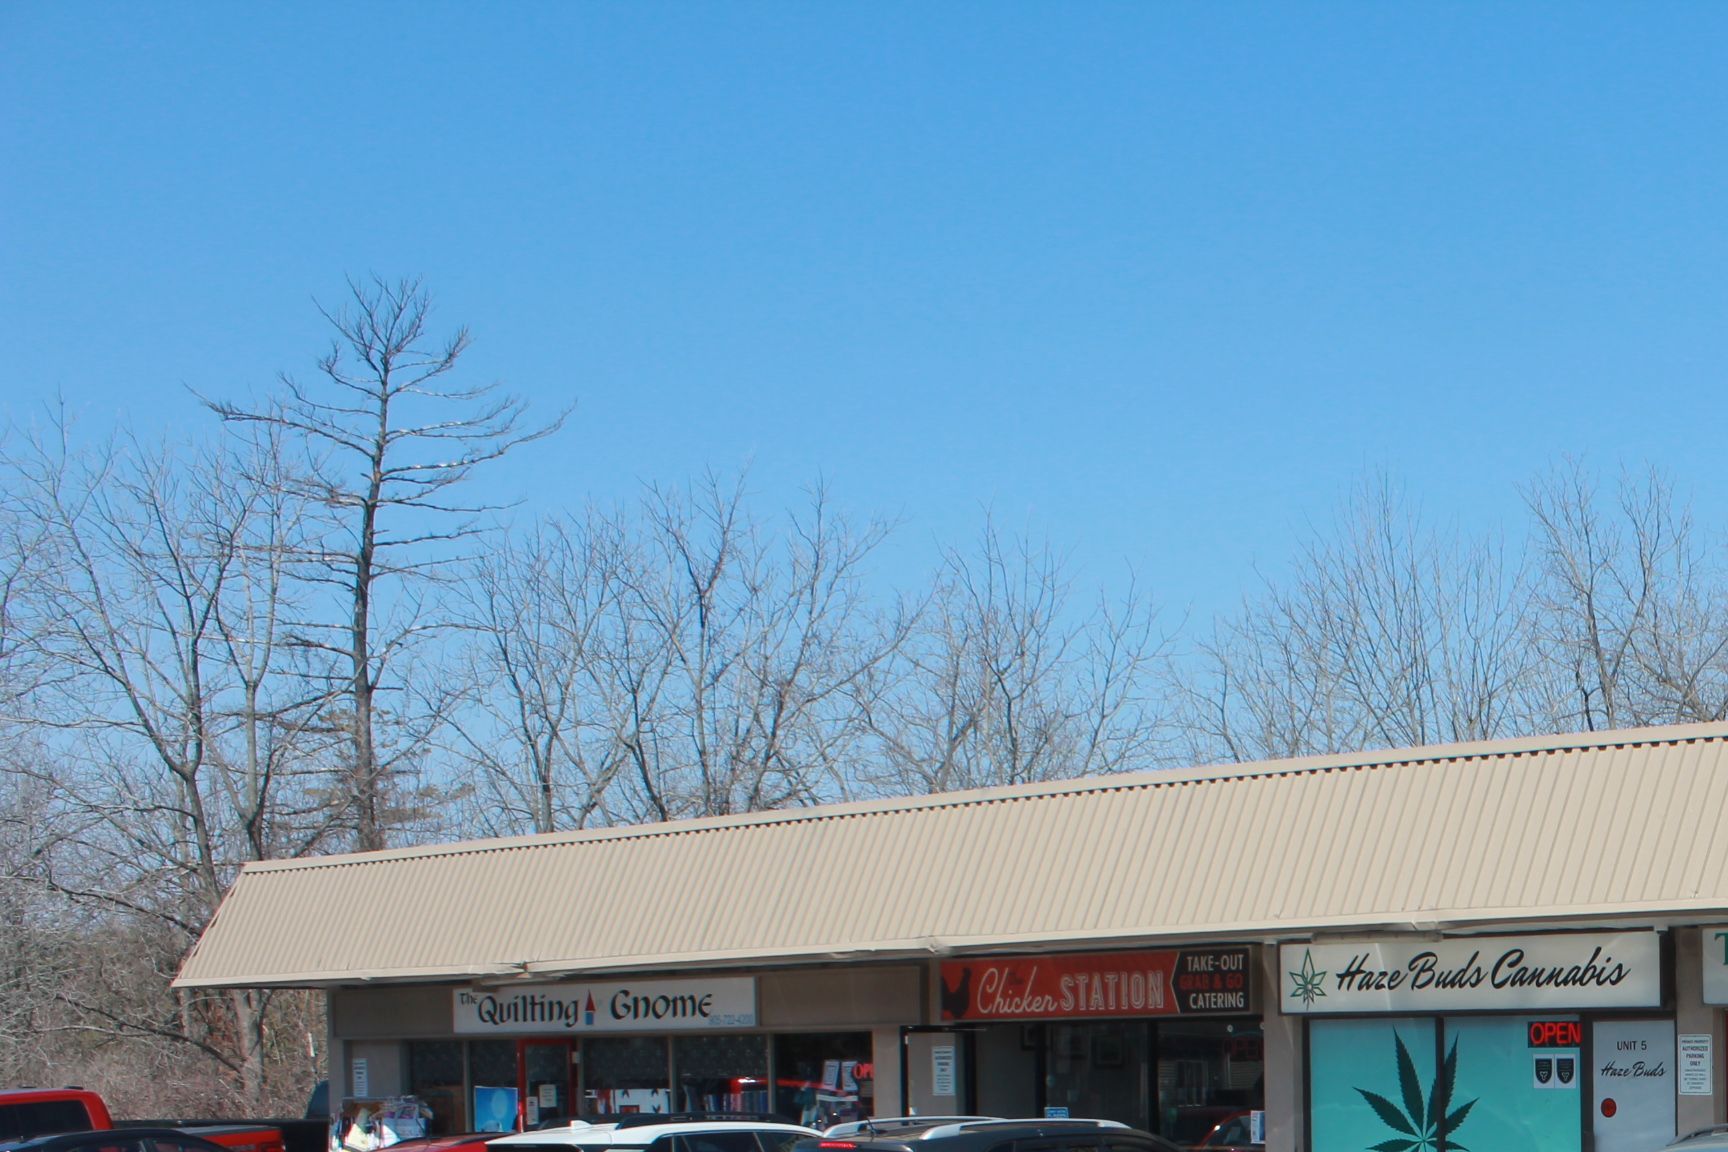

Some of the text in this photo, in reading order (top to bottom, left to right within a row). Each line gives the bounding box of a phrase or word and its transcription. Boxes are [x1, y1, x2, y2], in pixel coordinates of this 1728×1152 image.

[1186, 954, 1244, 972] TAKE-OUT
[1336, 946, 1631, 991] Haze Buds Cannabis
[977, 965, 1164, 1014] Chicken STATION
[460, 989, 713, 1027] The Quilting Gnome
[1189, 992, 1244, 1009] CATERING
[1530, 1022, 1583, 1044] OPEN
[1617, 1041, 1647, 1051] UNIT 5
[1601, 1060, 1666, 1077] Haze Buds
